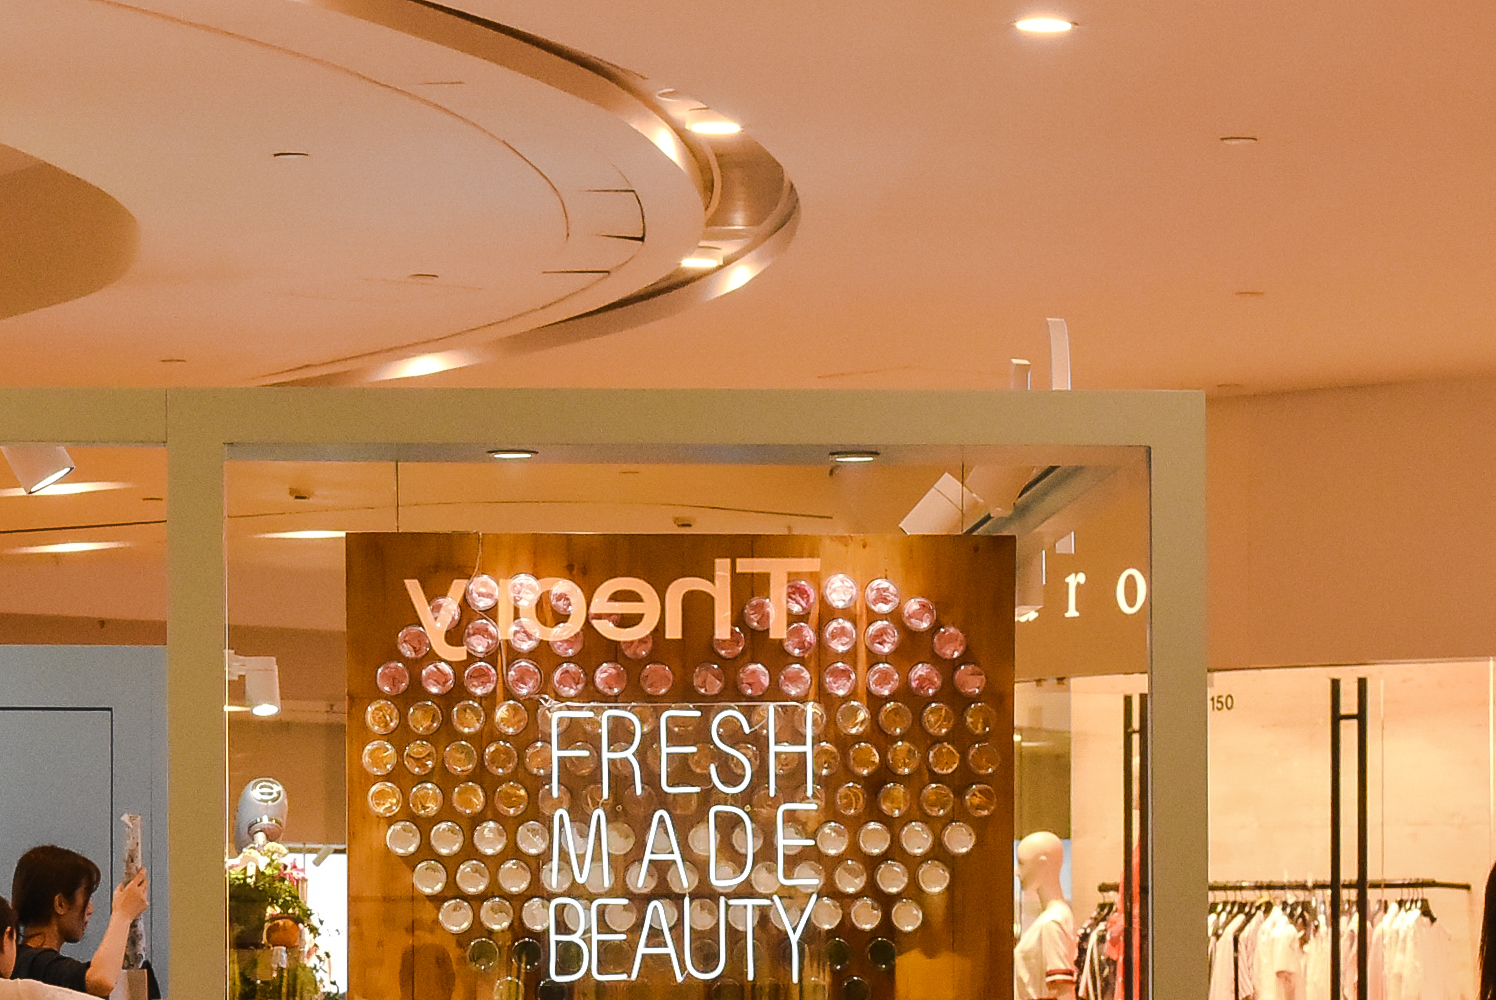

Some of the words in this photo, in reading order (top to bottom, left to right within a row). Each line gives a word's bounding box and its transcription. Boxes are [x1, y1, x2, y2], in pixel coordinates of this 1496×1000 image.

[1209, 694, 1235, 711] 150
[548, 701, 817, 799] FRESH
[549, 802, 821, 889] MADE
[547, 892, 819, 984] BEAUTY
